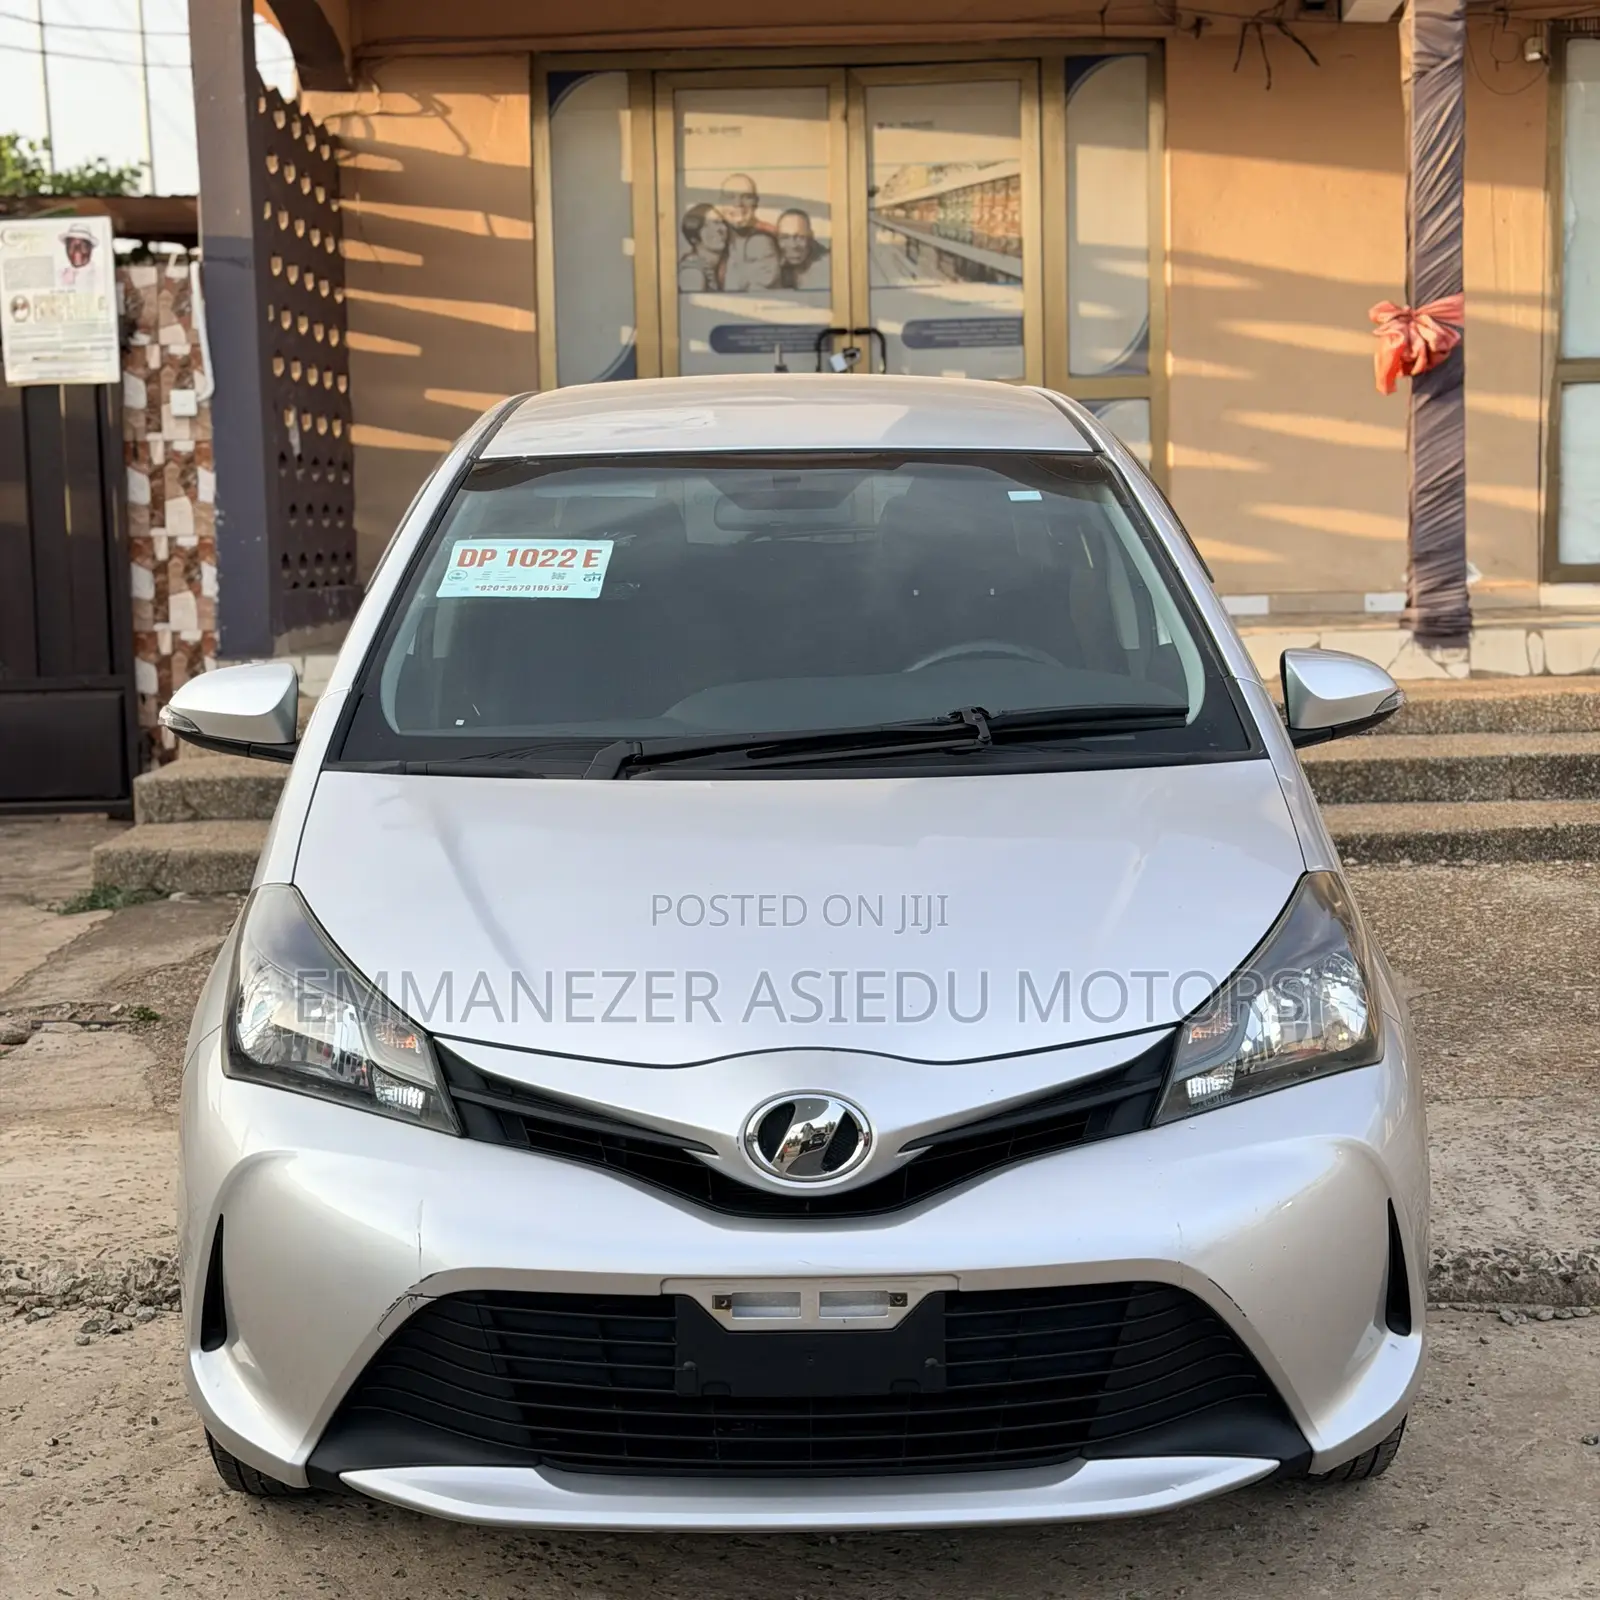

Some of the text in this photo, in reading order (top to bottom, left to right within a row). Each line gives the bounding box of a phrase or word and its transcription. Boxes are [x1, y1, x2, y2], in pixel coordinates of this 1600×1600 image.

[456, 548, 602, 568] DP 1022 E
